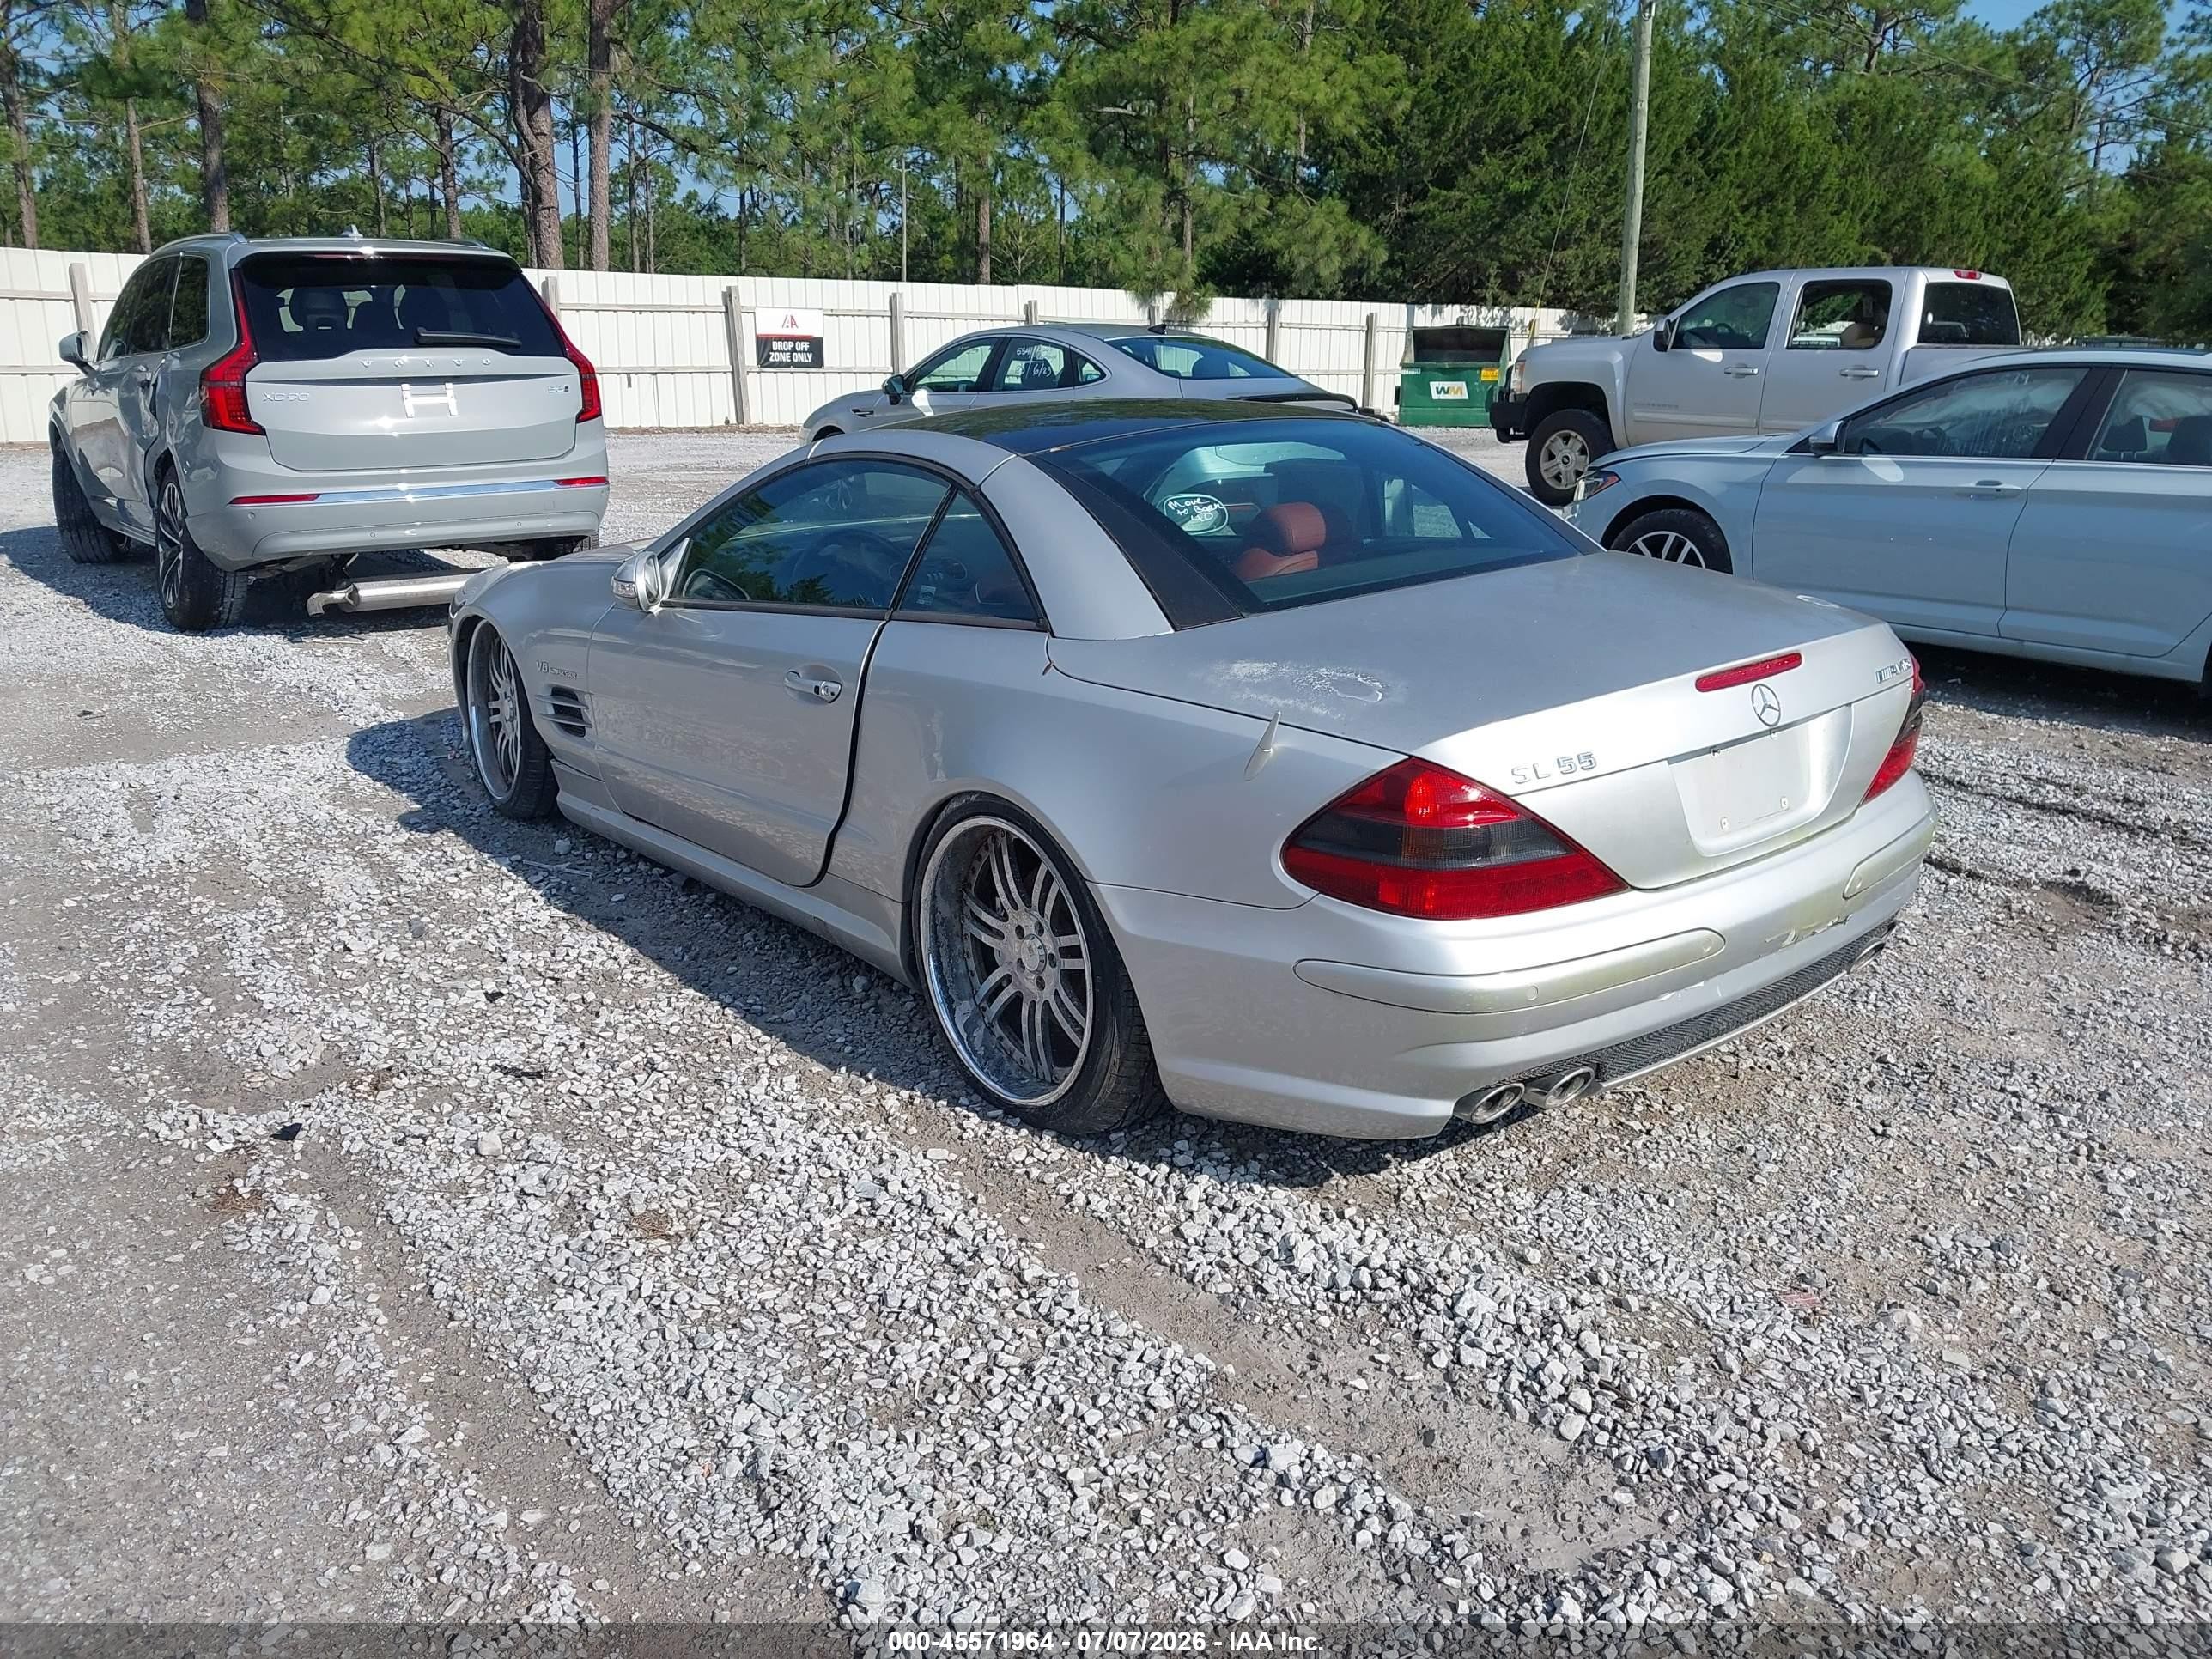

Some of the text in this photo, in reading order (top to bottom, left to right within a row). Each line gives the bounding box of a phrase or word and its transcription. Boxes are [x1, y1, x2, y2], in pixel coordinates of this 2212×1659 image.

[772, 341, 810, 351] DROP OFF
[769, 352, 812, 362] ZONE ONLY
[360, 357, 492, 368] VOLVO
[1436, 386, 1463, 395] WM
[262, 392, 310, 402] XC90
[536, 659, 550, 673] V8
[1511, 751, 1597, 784] SL 55
